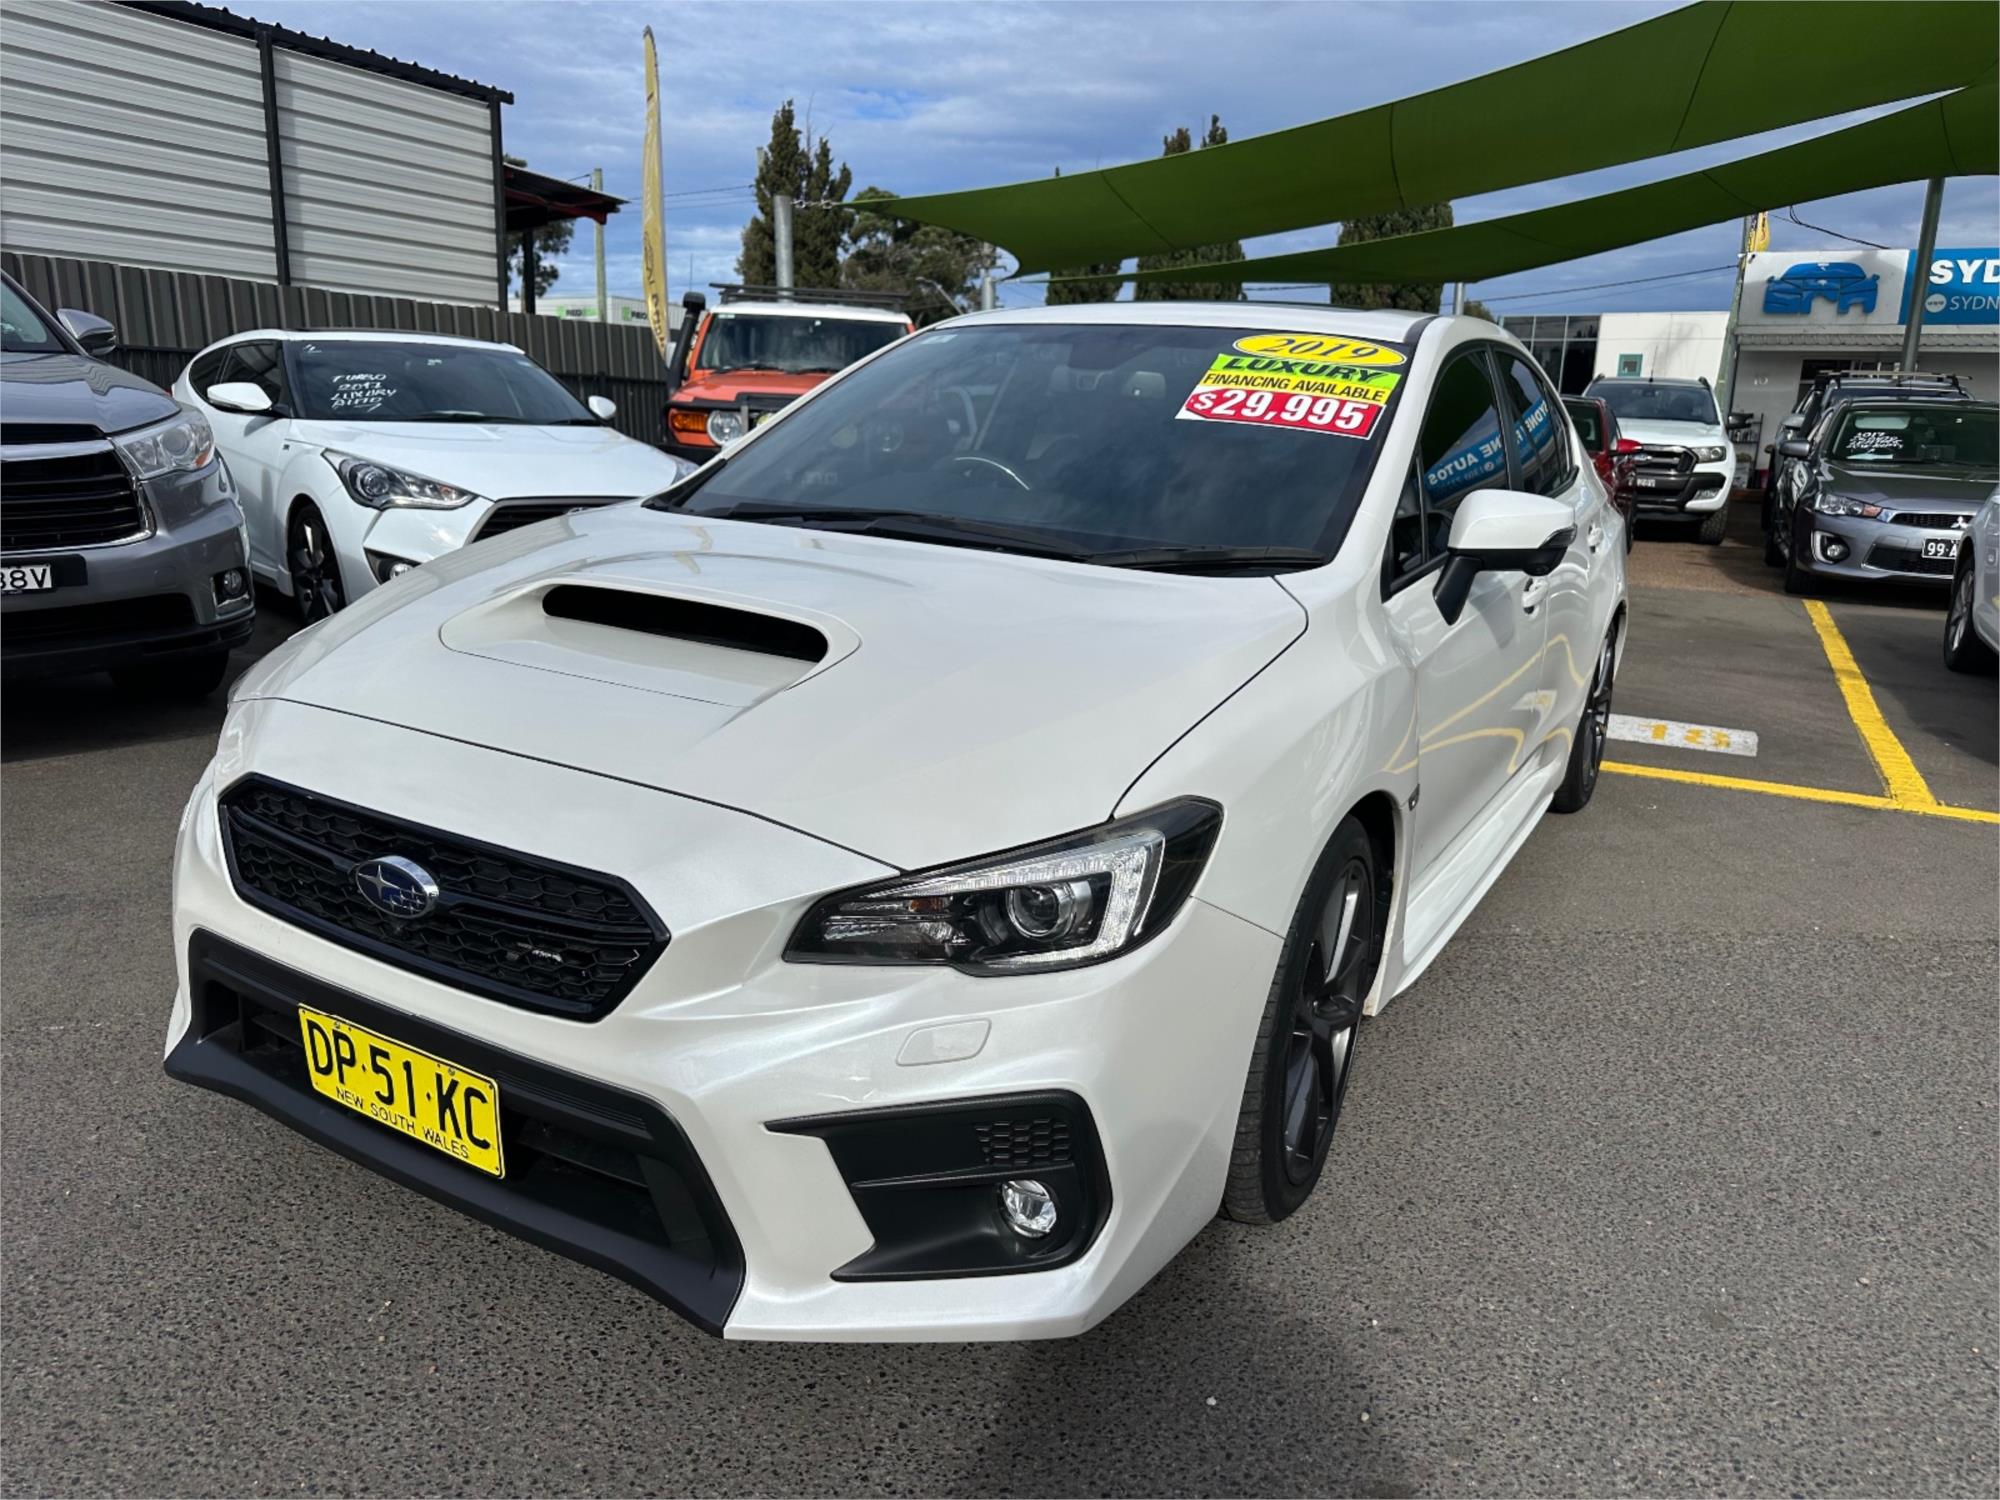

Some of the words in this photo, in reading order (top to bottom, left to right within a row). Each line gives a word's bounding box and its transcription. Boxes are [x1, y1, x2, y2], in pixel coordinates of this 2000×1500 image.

[1260, 338, 1380, 360] 2019
[1223, 357, 1387, 382] LUXURY
[1203, 373, 1291, 390] FINANCING
[1293, 379, 1386, 402] AVAILABLE
[1193, 389, 1370, 430] $29,995
[336, 1086, 364, 1110] NEW
[370, 1103, 416, 1135] SOUTH
[422, 1126, 470, 1160] WALES
